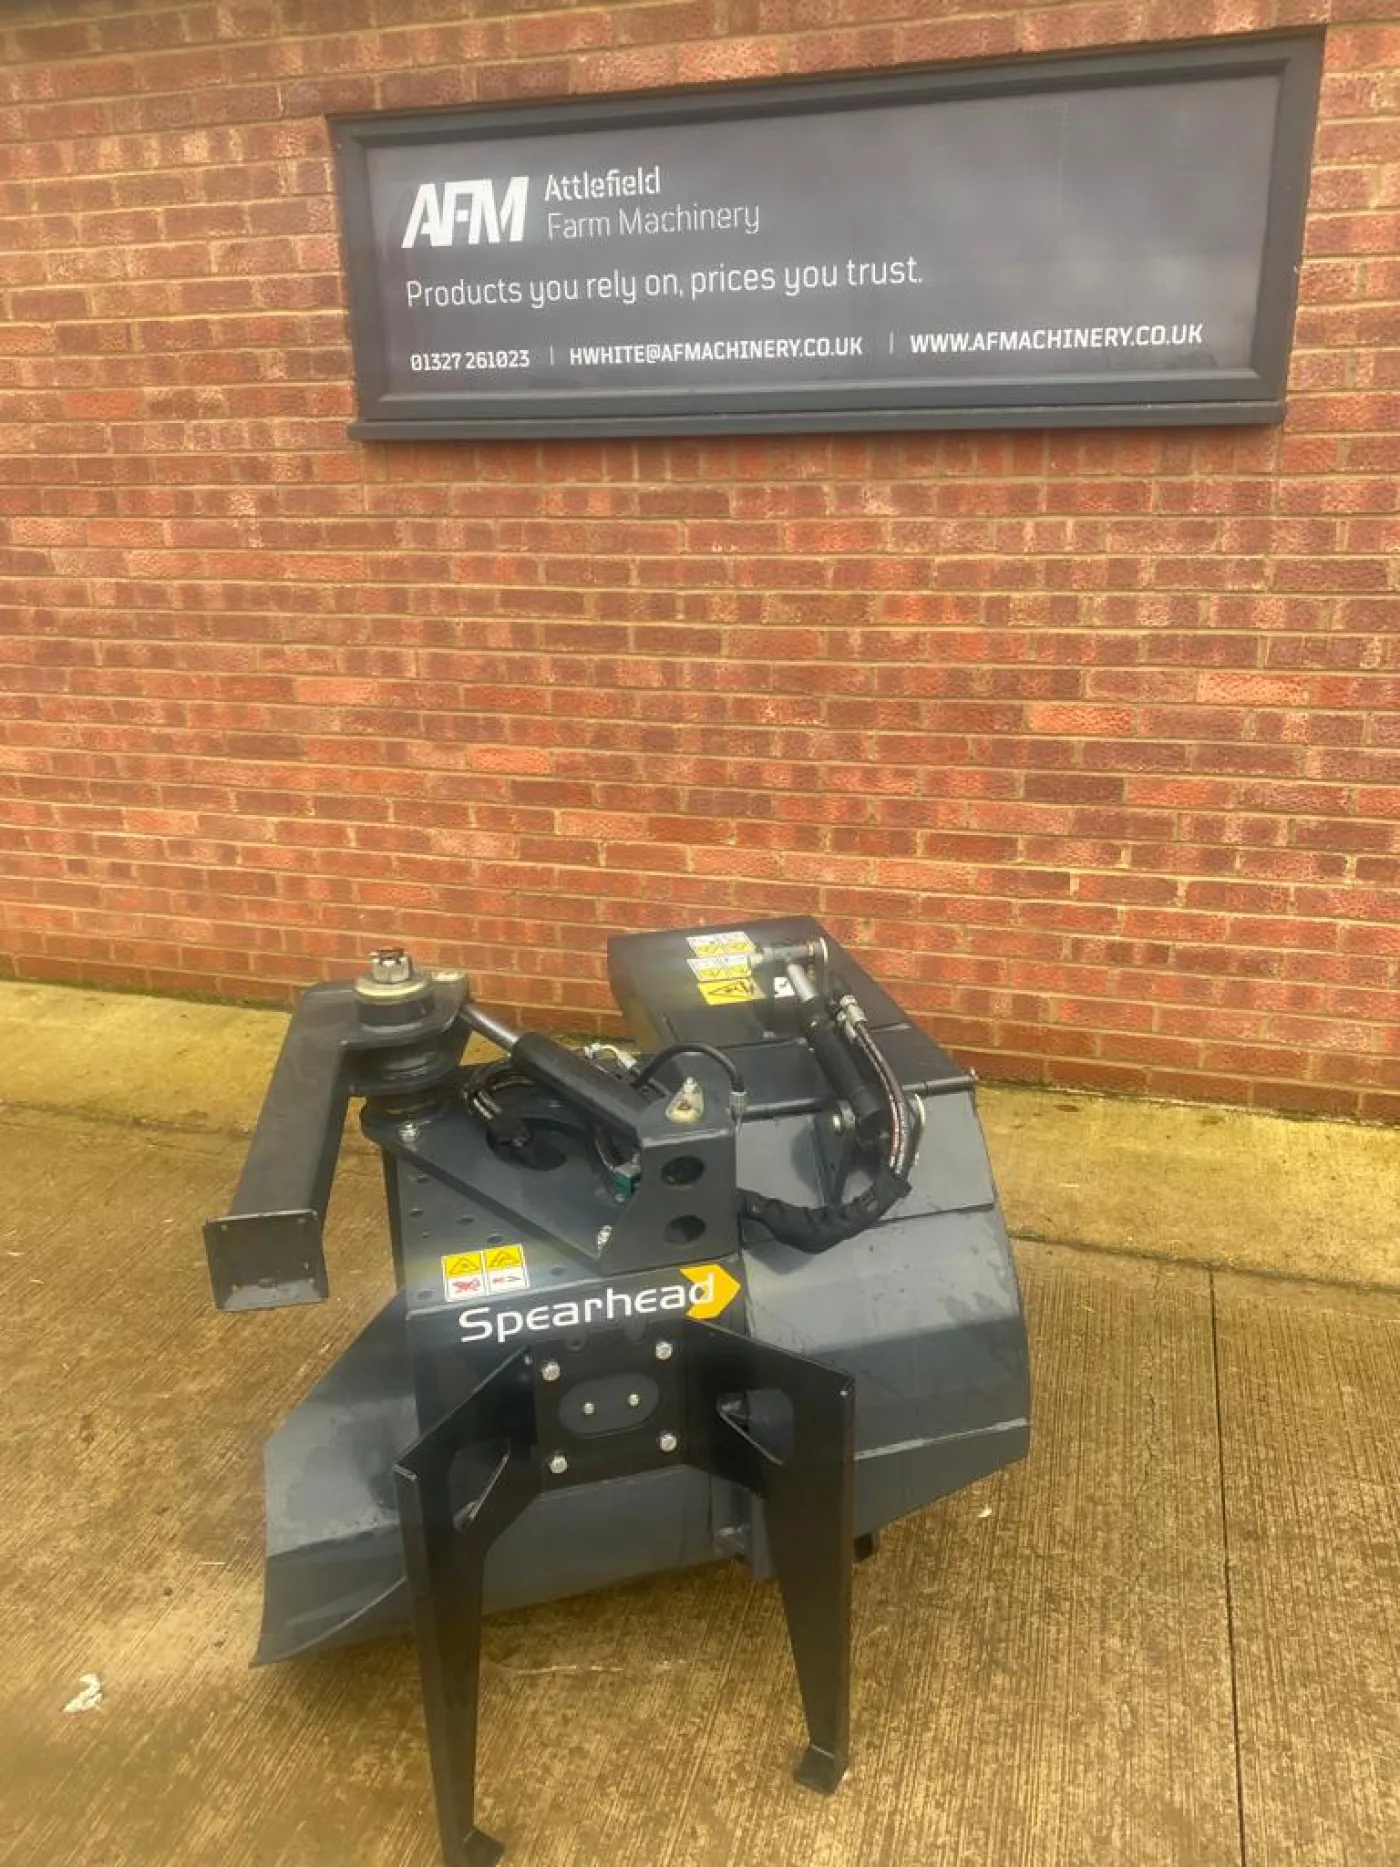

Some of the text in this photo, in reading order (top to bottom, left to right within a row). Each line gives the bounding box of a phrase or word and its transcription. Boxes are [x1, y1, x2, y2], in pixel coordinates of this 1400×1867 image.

[544, 165, 661, 201] Attlefield
[400, 175, 530, 249] AFM
[547, 202, 761, 241] Farm Machinery
[405, 255, 924, 309] Products you rely on, prices you trust.
[569, 335, 863, 367] HWHITE@AFMACHINERY.CO.UK
[909, 323, 1205, 354] WWW.AFMACHINERY.CO.UK
[410, 349, 531, 371] 01327 261023
[458, 1272, 715, 1343] Spearhead
